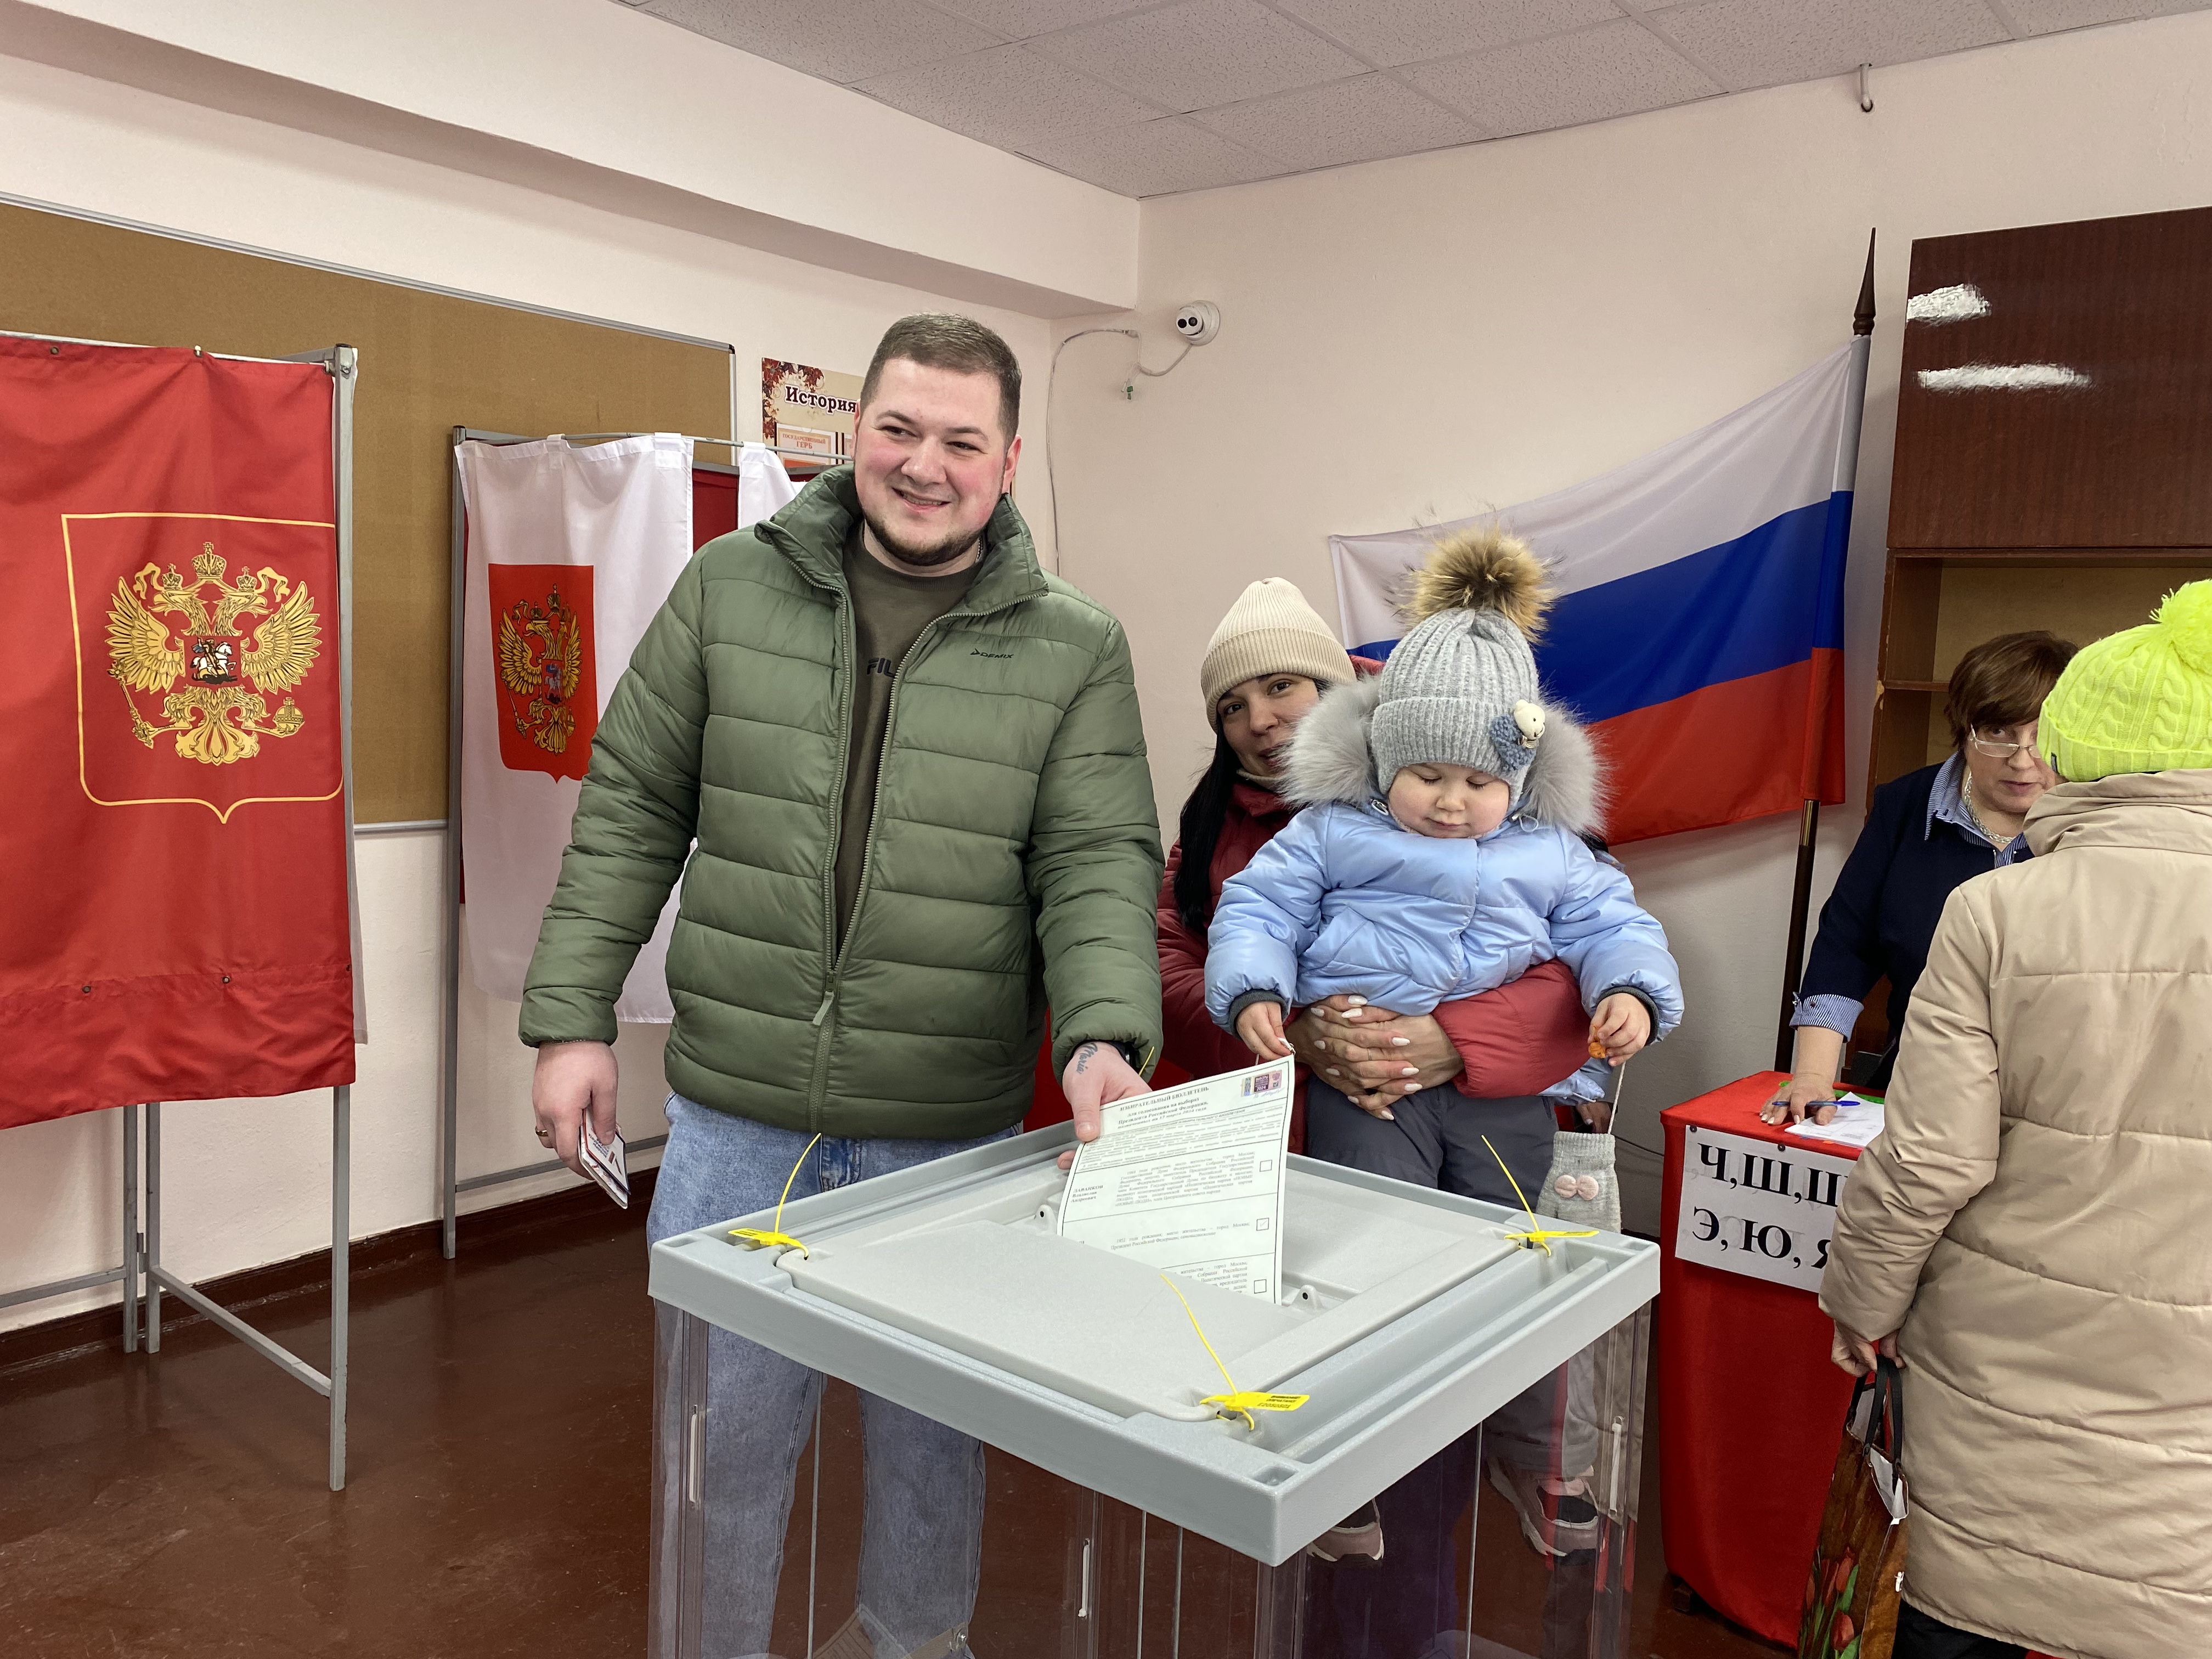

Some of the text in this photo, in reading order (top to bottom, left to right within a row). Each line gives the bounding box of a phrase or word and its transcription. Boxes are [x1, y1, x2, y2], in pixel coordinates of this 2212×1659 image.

[785, 386, 856, 413] История
[783, 433, 826, 444] ГОСУДАРСТВЕННЫЙ
[867, 658, 895, 679] FIL
[1120, 1087, 1209, 1111] ИЗБИРАТЕЛЬНЫЙ БЮЛЛЕТЕНЬ
[1692, 1206, 1728, 1251] Э,
[1740, 1218, 1801, 1268] Ю,
